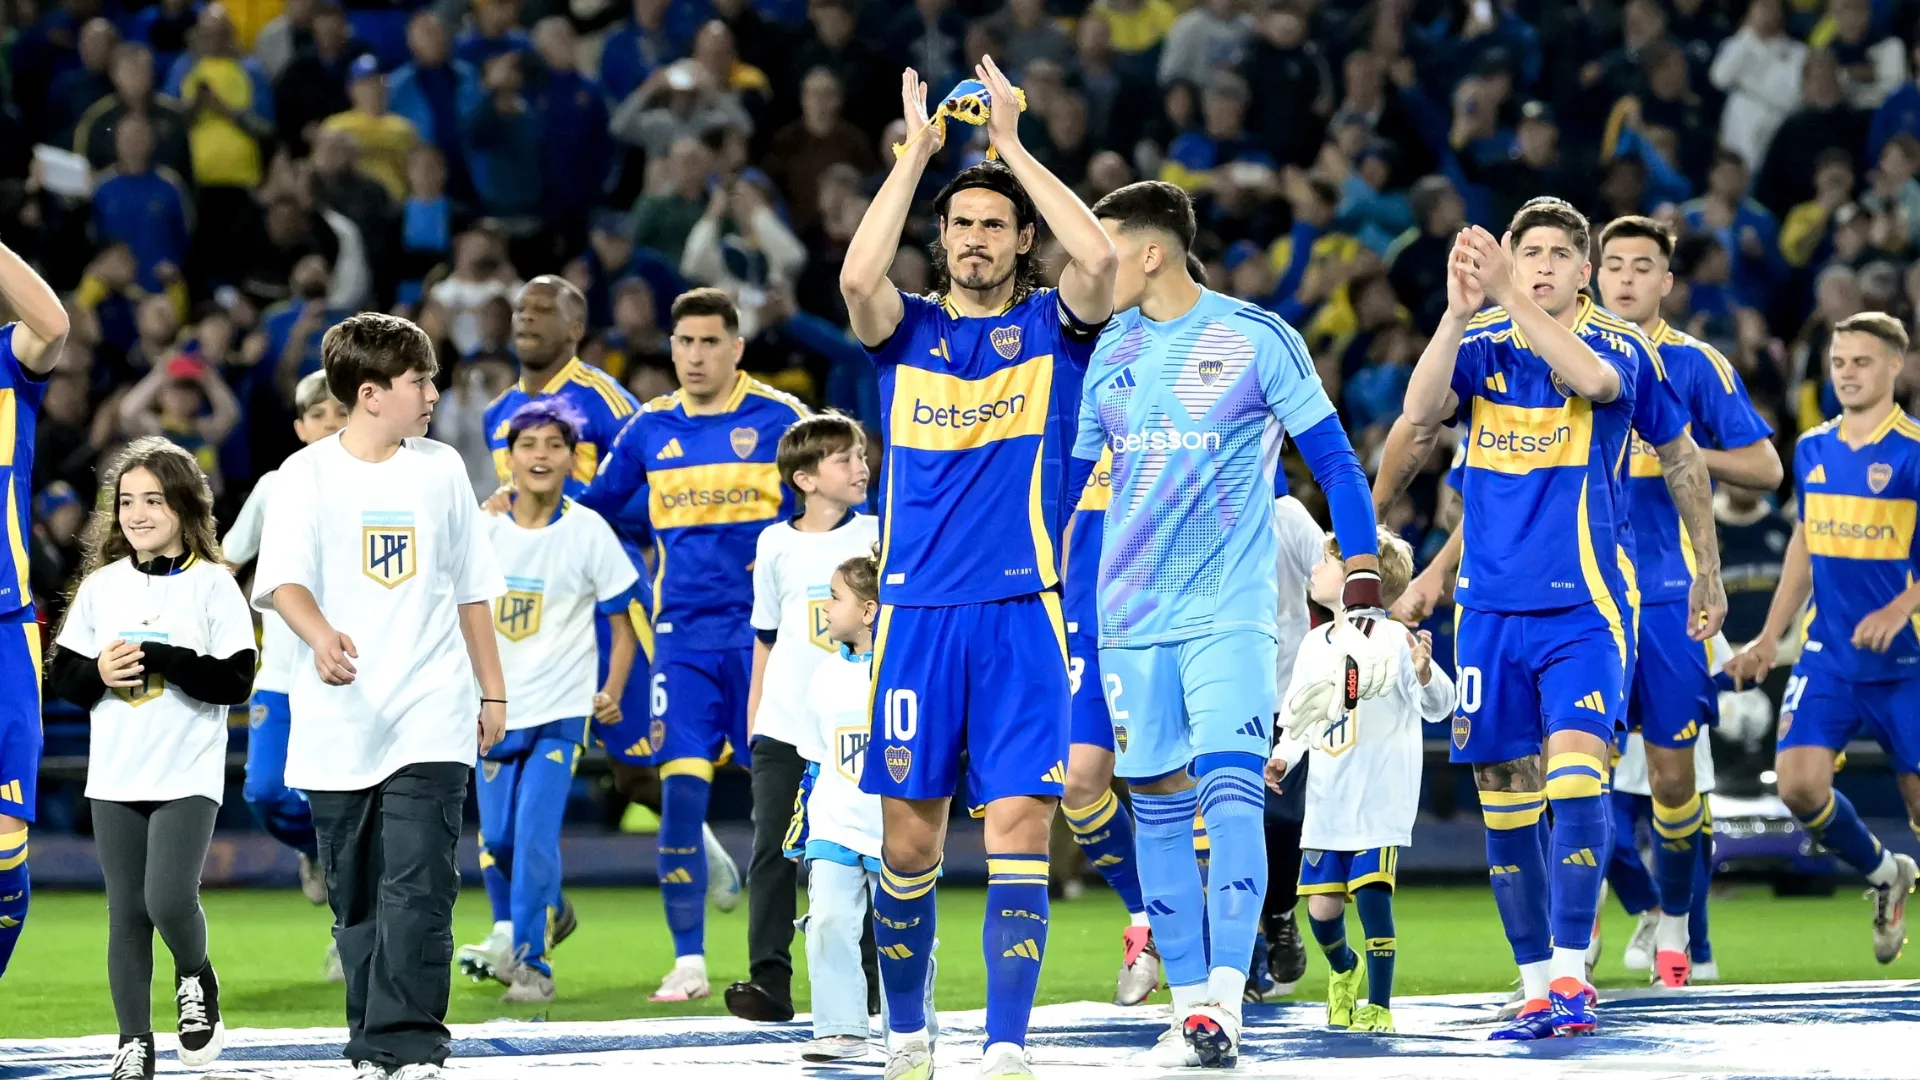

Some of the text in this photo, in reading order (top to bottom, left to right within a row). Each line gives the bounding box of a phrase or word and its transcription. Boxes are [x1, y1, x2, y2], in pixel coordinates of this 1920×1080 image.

[912, 394, 1026, 429] betsson
[1111, 427, 1221, 453] betsson
[660, 488, 759, 510] betsson
[1810, 518, 1895, 540] betsson
[370, 534, 409, 578] LPF
[501, 597, 535, 633] LPF
[1347, 668, 1357, 699] adidas
[884, 687, 918, 742] 10
[873, 908, 921, 930] CABJ
[1001, 909, 1048, 925] CABJ
